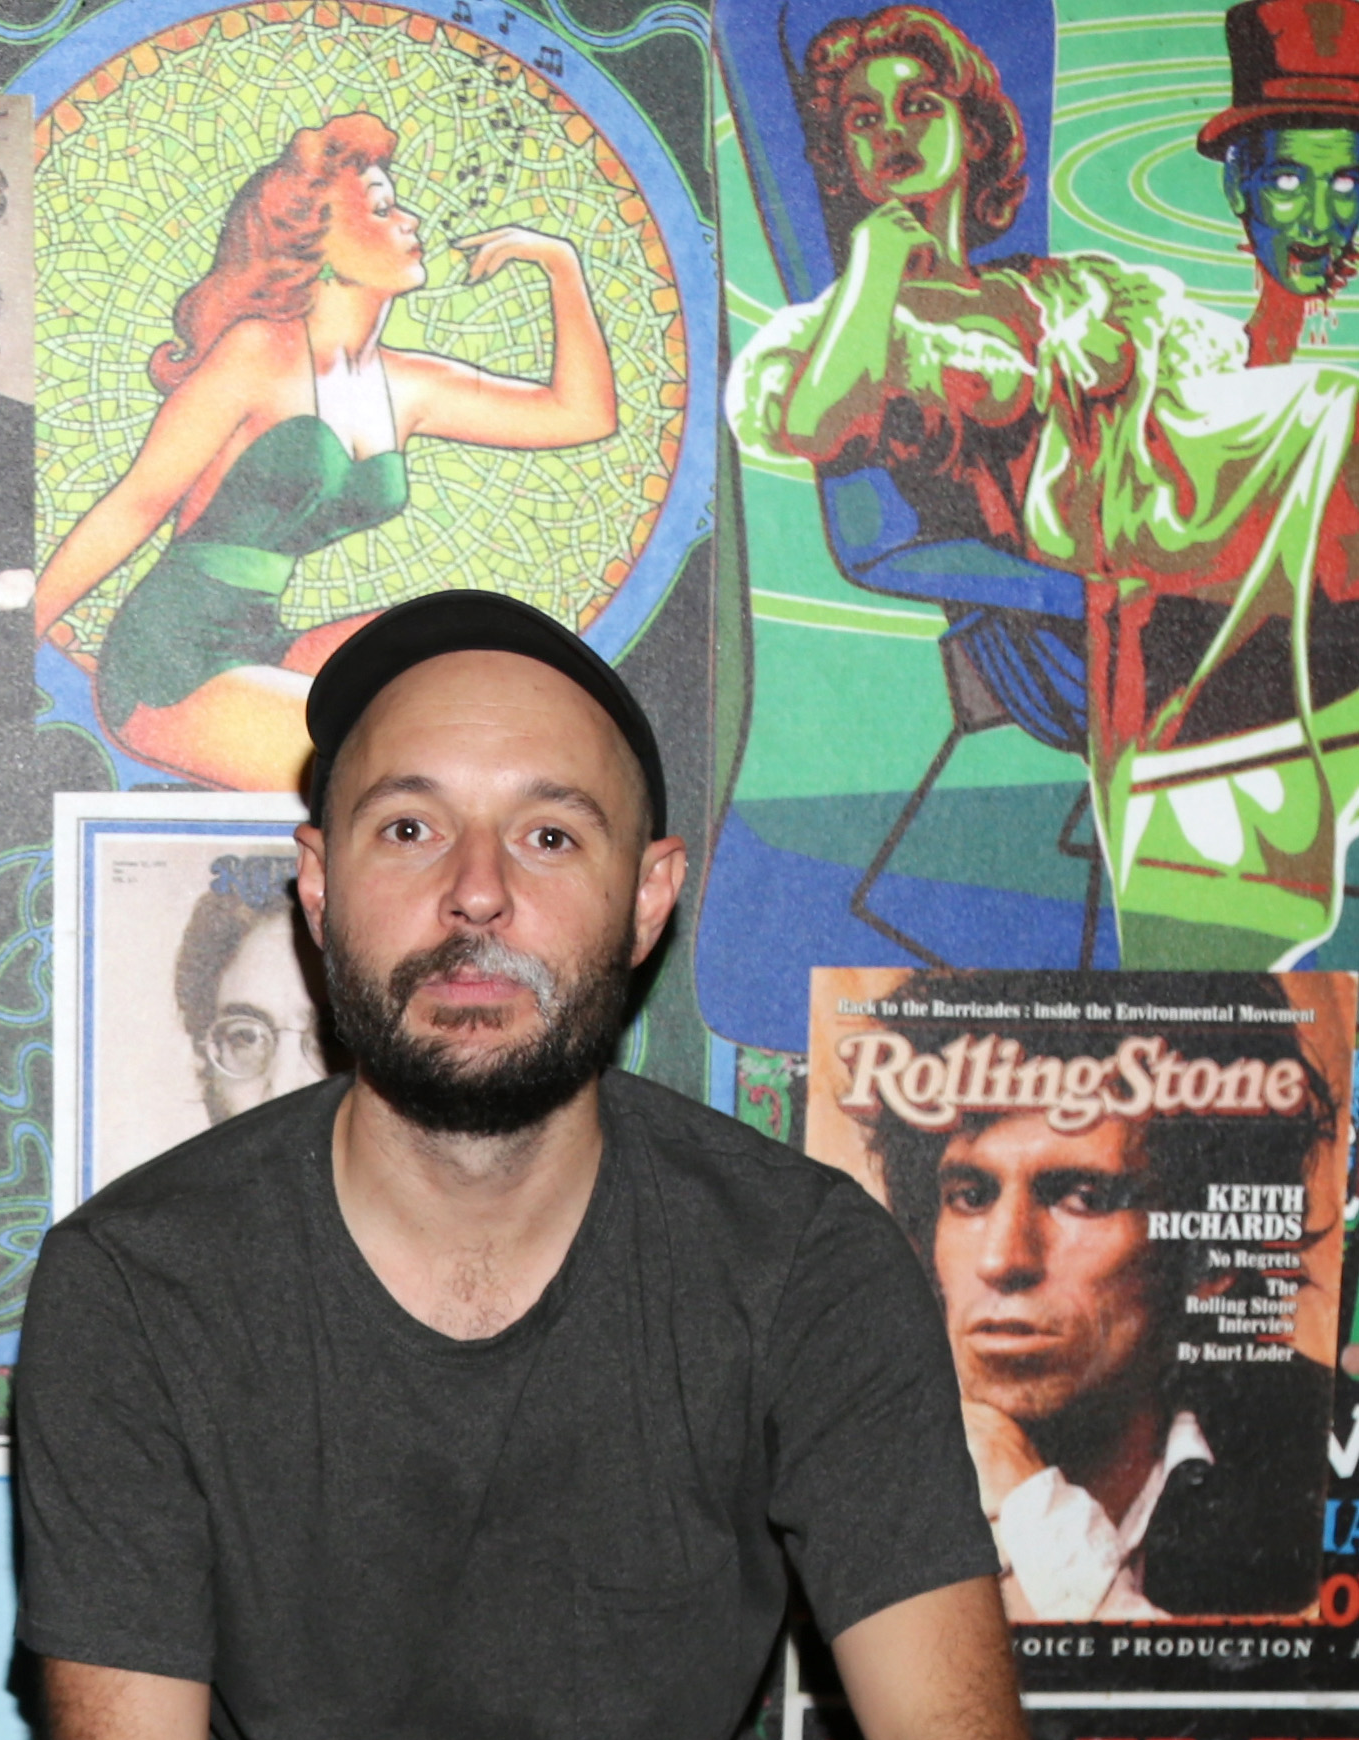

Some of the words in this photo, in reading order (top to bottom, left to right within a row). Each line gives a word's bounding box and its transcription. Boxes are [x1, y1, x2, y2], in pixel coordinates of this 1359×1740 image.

[837, 999, 878, 1016] Back
[881, 1001, 899, 1016] to
[902, 1001, 929, 1017] the
[932, 1000, 1021, 1019] Barricades
[1085, 1002, 1112, 1021] the
[1116, 1003, 1234, 1022] Environmental
[1239, 1004, 1316, 1023] Movement
[835, 1029, 1113, 1135] Rolling
[1102, 1033, 1309, 1116] Stone
[1207, 1183, 1305, 1213] KEITH
[1148, 1211, 1303, 1241] RICHARDS
[1208, 1249, 1231, 1267] No
[1234, 1249, 1301, 1270] Regrets
[1265, 1278, 1299, 1296] The
[1185, 1296, 1247, 1317] Rolling
[1250, 1297, 1297, 1315] Stone
[1218, 1316, 1295, 1334] Interview
[1177, 1342, 1201, 1364] By
[1202, 1342, 1241, 1362] Kurt
[1246, 1343, 1294, 1362] Loder
[1011, 1637, 1095, 1658] OICE
[1111, 1637, 1314, 1659] PRODUCTION
